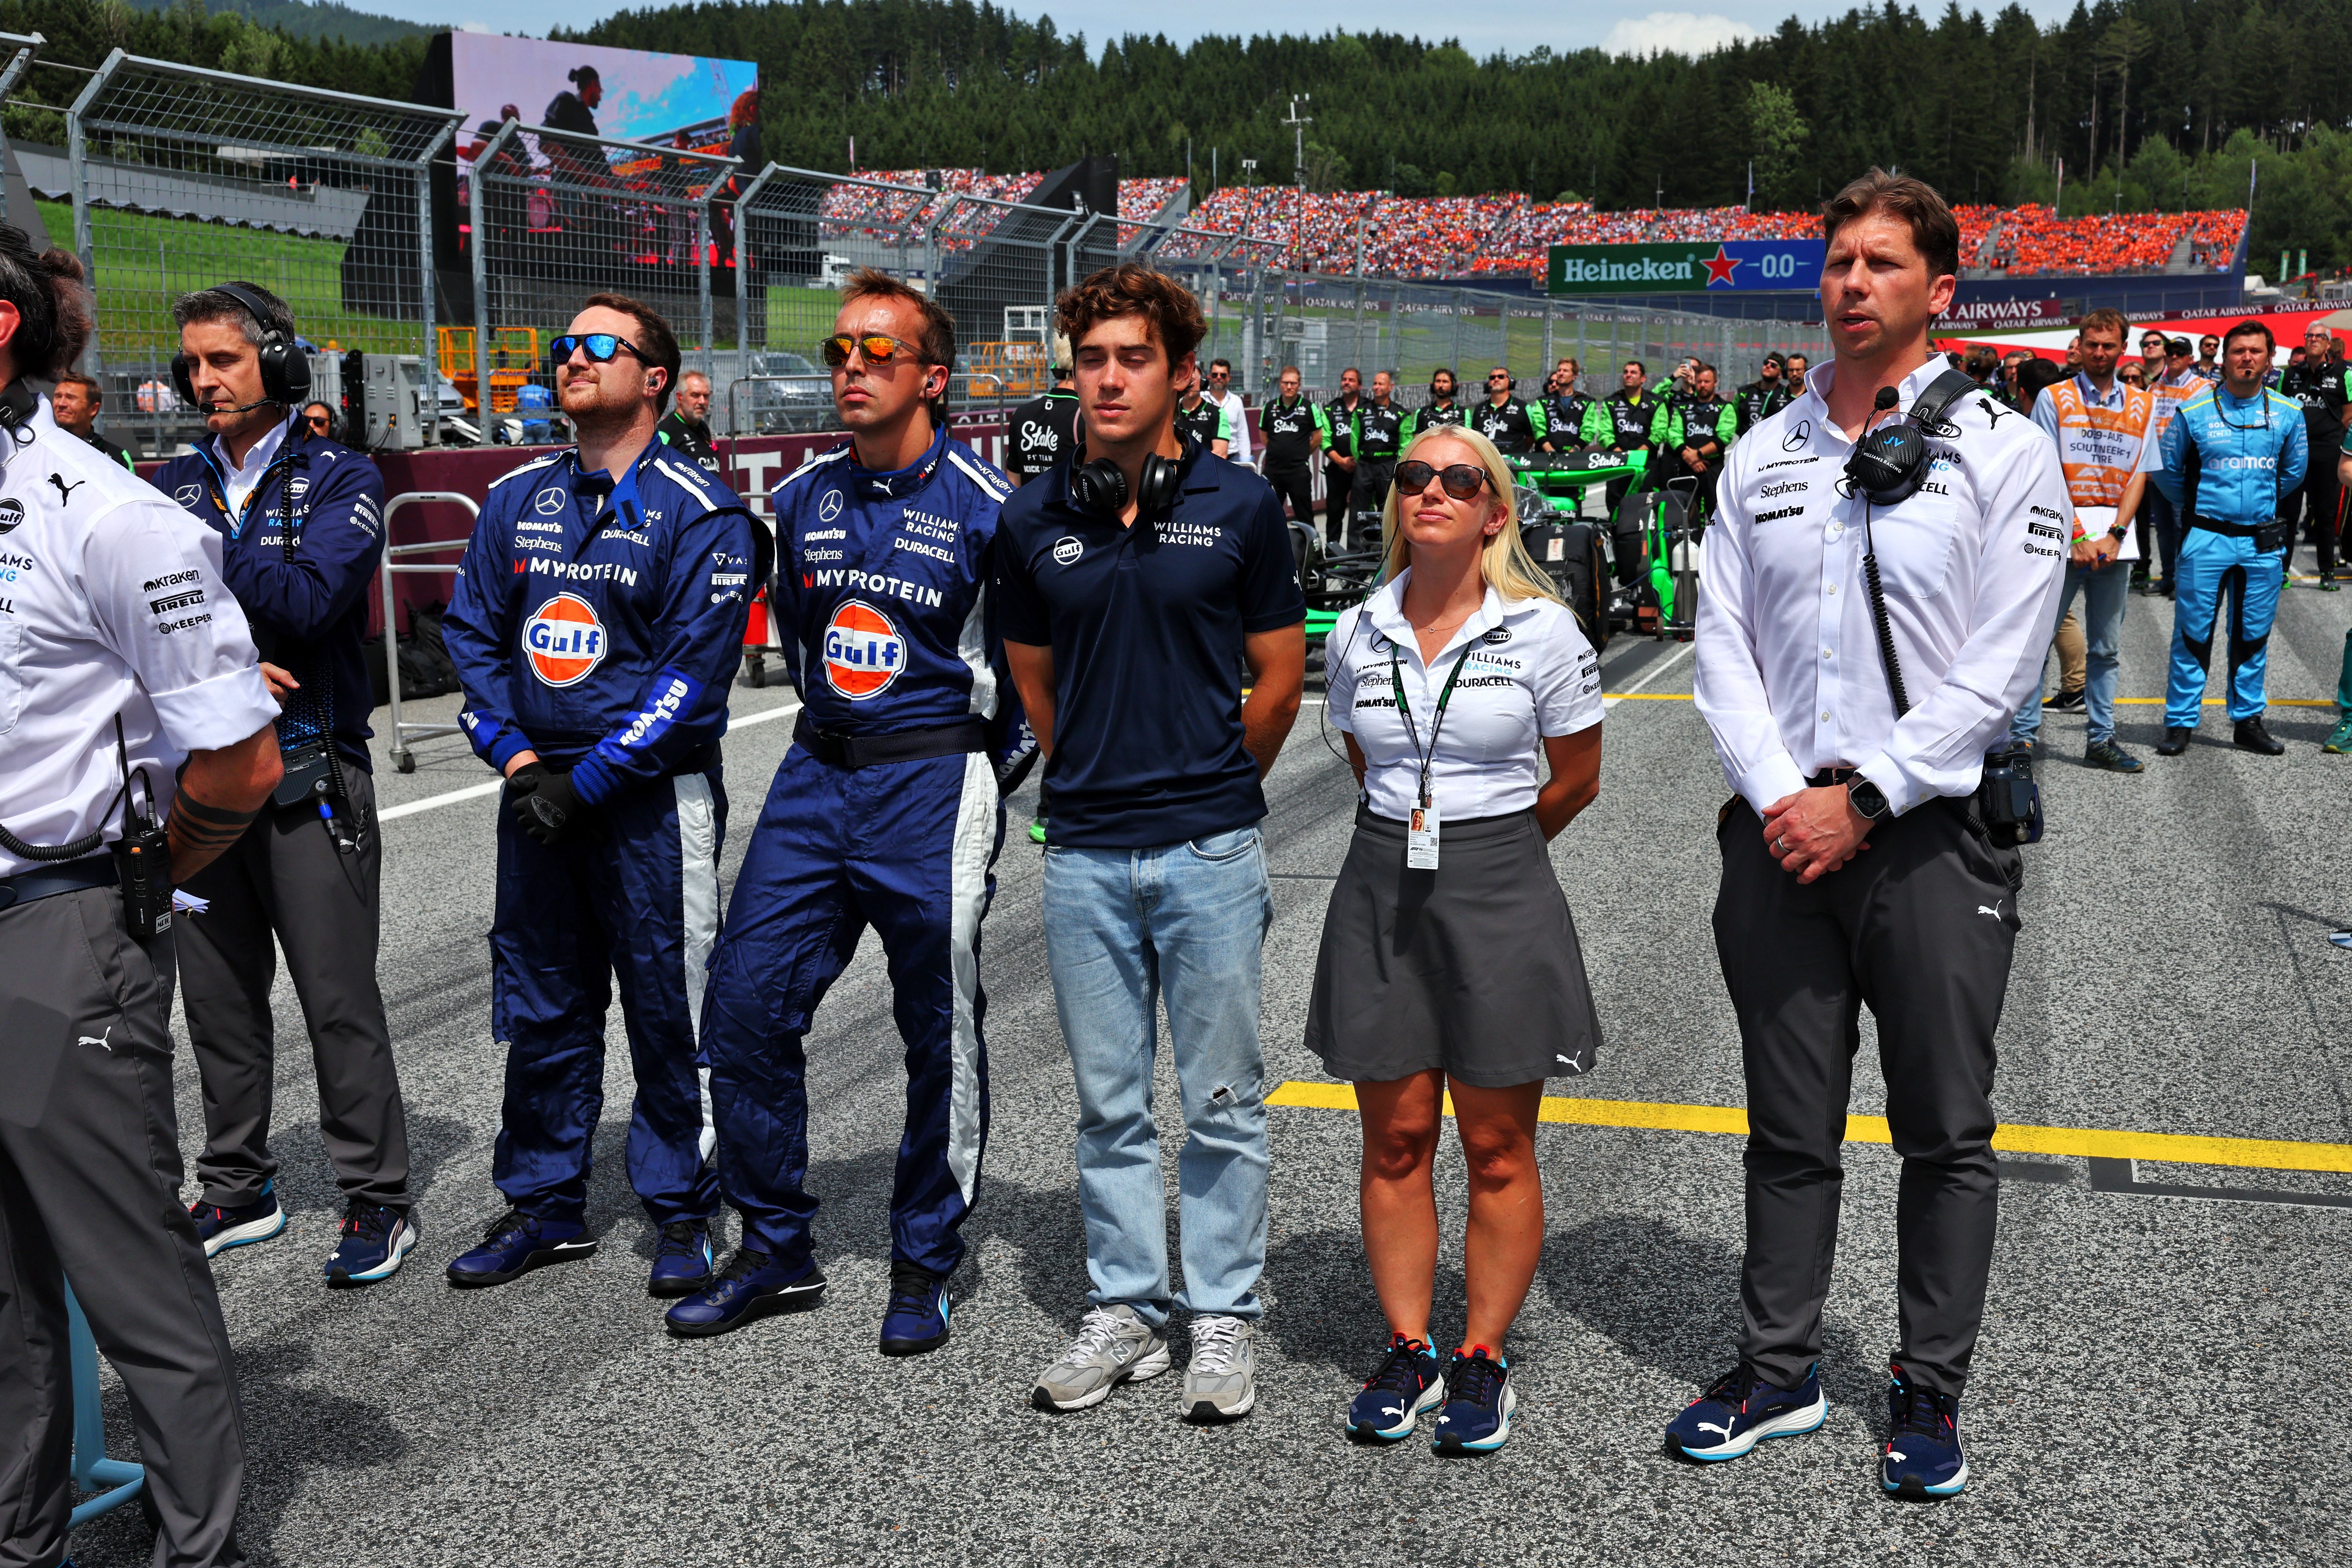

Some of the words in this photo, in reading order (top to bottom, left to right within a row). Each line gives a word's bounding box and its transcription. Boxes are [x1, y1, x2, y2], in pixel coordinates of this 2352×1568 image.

[1564, 257, 1692, 282] Heineken
[1955, 301, 2042, 319] AIRWAYS
[2182, 308, 2216, 319] QATAR
[2219, 305, 2264, 317] AIRWAYS
[2274, 302, 2310, 313] QATAR
[2313, 299, 2352, 310] AIRWAY
[1937, 321, 1978, 330] AIRWAYS
[1993, 319, 2026, 329] QATAR
[2029, 317, 2070, 327] AIRWAYS
[1274, 419, 1299, 433] Stake
[1365, 427, 1389, 442] Stake
[1617, 419, 1643, 434] Stake
[1687, 422, 1713, 437] Stake
[1020, 421, 1058, 451] Stake
[1884, 436, 1905, 447] JV
[1766, 456, 1820, 470] MYPROTEIN
[1863, 452, 1884, 463] WILLIAMS
[1883, 459, 1902, 474] RACING
[2209, 456, 2275, 470] aramco
[682, 466, 710, 487] kraken
[980, 466, 1013, 493] kraken
[1761, 481, 1808, 499] Stephens
[0, 513, 21, 523] ulf
[354, 503, 379, 530] PIRELLI
[1755, 506, 1804, 524] KOMATSU
[601, 529, 650, 546] DURACELL
[804, 528, 846, 542] KOMATSU
[906, 521, 955, 543] RACING
[1154, 522, 1221, 537] WILLIAMS
[2028, 522, 2064, 545] PIRELLI
[514, 536, 562, 553] Stephens
[1159, 534, 1213, 547] RACING
[804, 546, 843, 563] Stephens
[894, 537, 955, 563] DURACELL
[1056, 544, 1080, 556] Gulf
[155, 570, 199, 588] kraken
[530, 557, 637, 587] MYPROTEIN
[817, 569, 942, 608] MYPROTEIN
[149, 590, 205, 614] PIRELLI
[171, 613, 212, 631] KEEPER
[529, 623, 600, 654] Gulf
[826, 631, 899, 666] Gulf
[1465, 662, 1512, 675] RACING
[1361, 675, 1394, 688] Stephen
[1454, 677, 1513, 688] DURACELL
[1355, 697, 1397, 709] KOMATSU
[157, 917, 171, 928] MRTC
